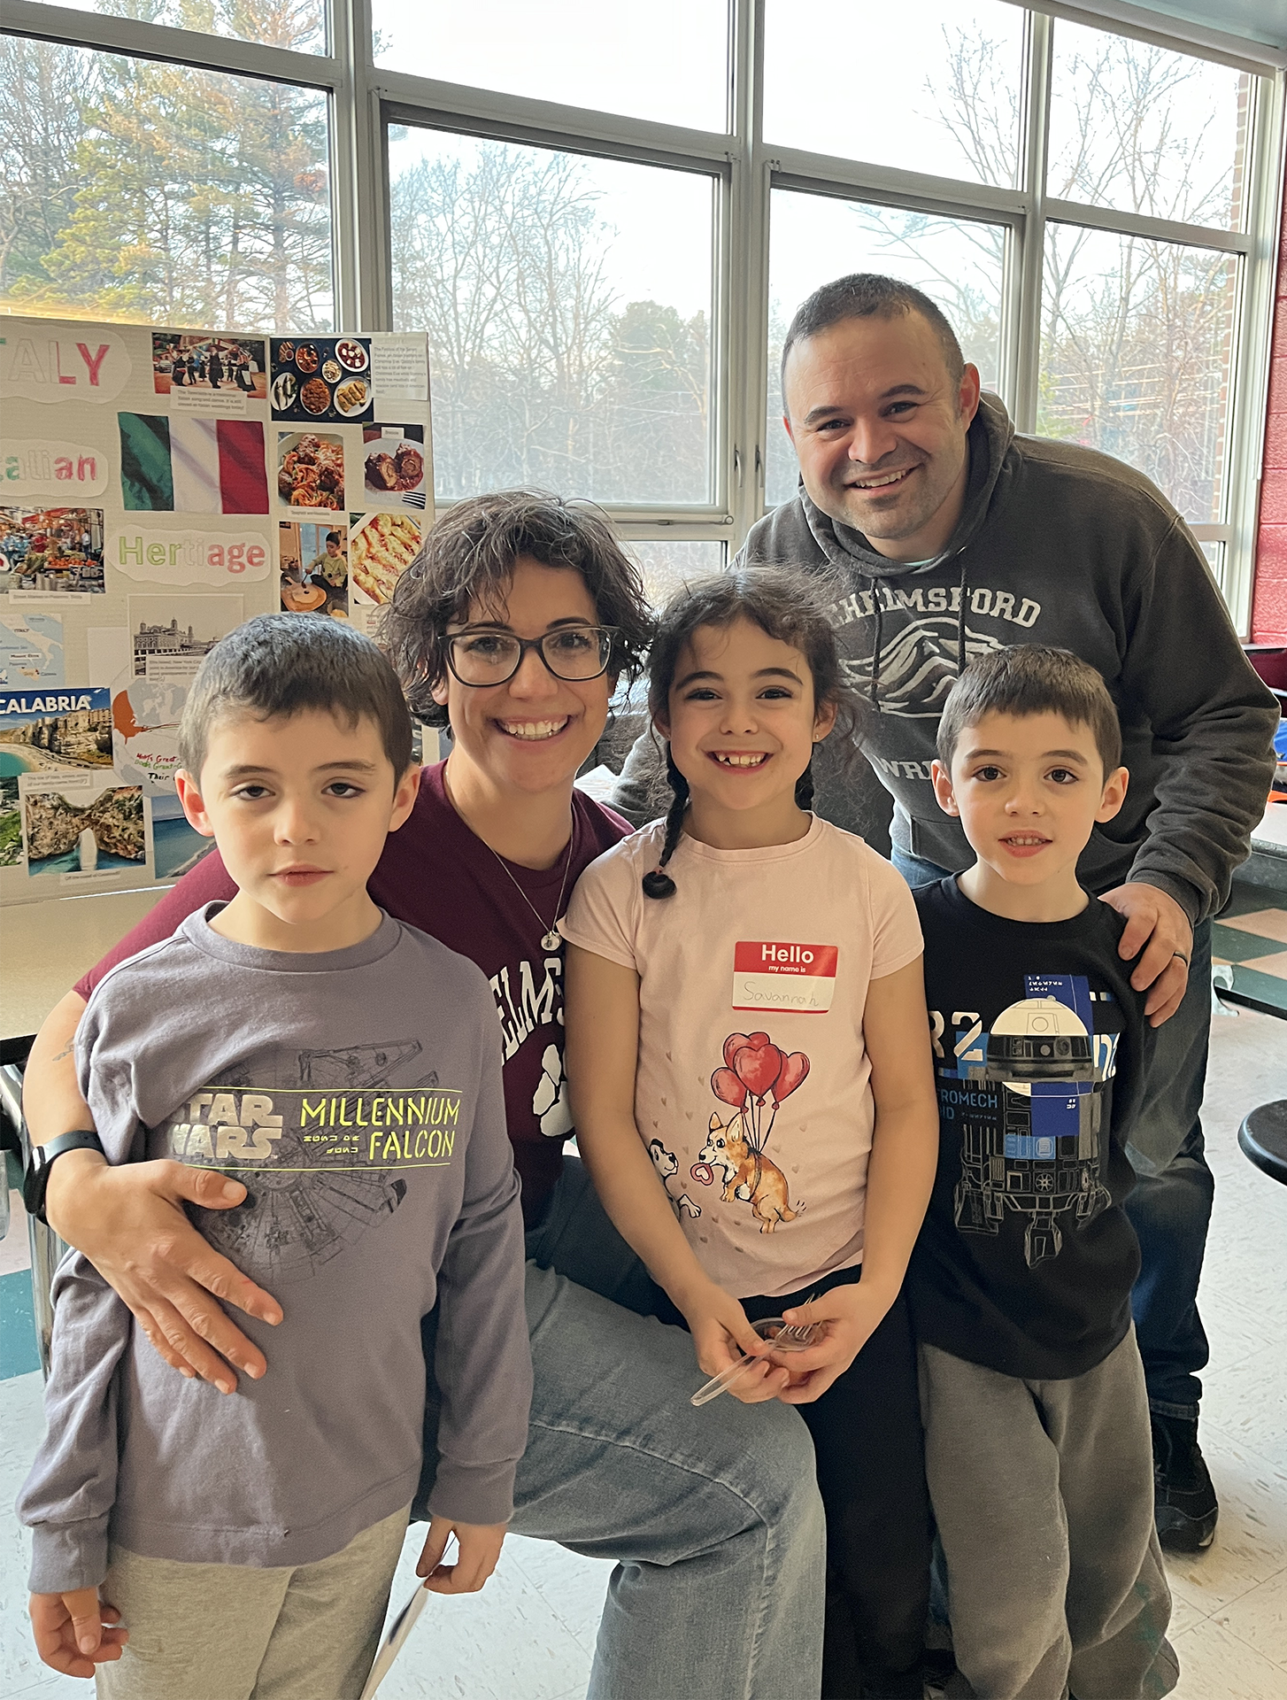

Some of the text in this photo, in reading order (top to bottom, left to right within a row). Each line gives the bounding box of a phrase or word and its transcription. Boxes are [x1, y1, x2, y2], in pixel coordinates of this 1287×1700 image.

[0, 337, 110, 386] ALY
[0, 450, 97, 481] alian
[119, 536, 265, 574] Hertiage
[761, 944, 814, 964] Hello
[768, 965, 779, 973] my
[300, 1097, 461, 1127] MILLENNIUM
[937, 1089, 998, 1108] ROMECH
[939, 1105, 955, 1120] ID
[369, 1130, 455, 1160] FALCON
